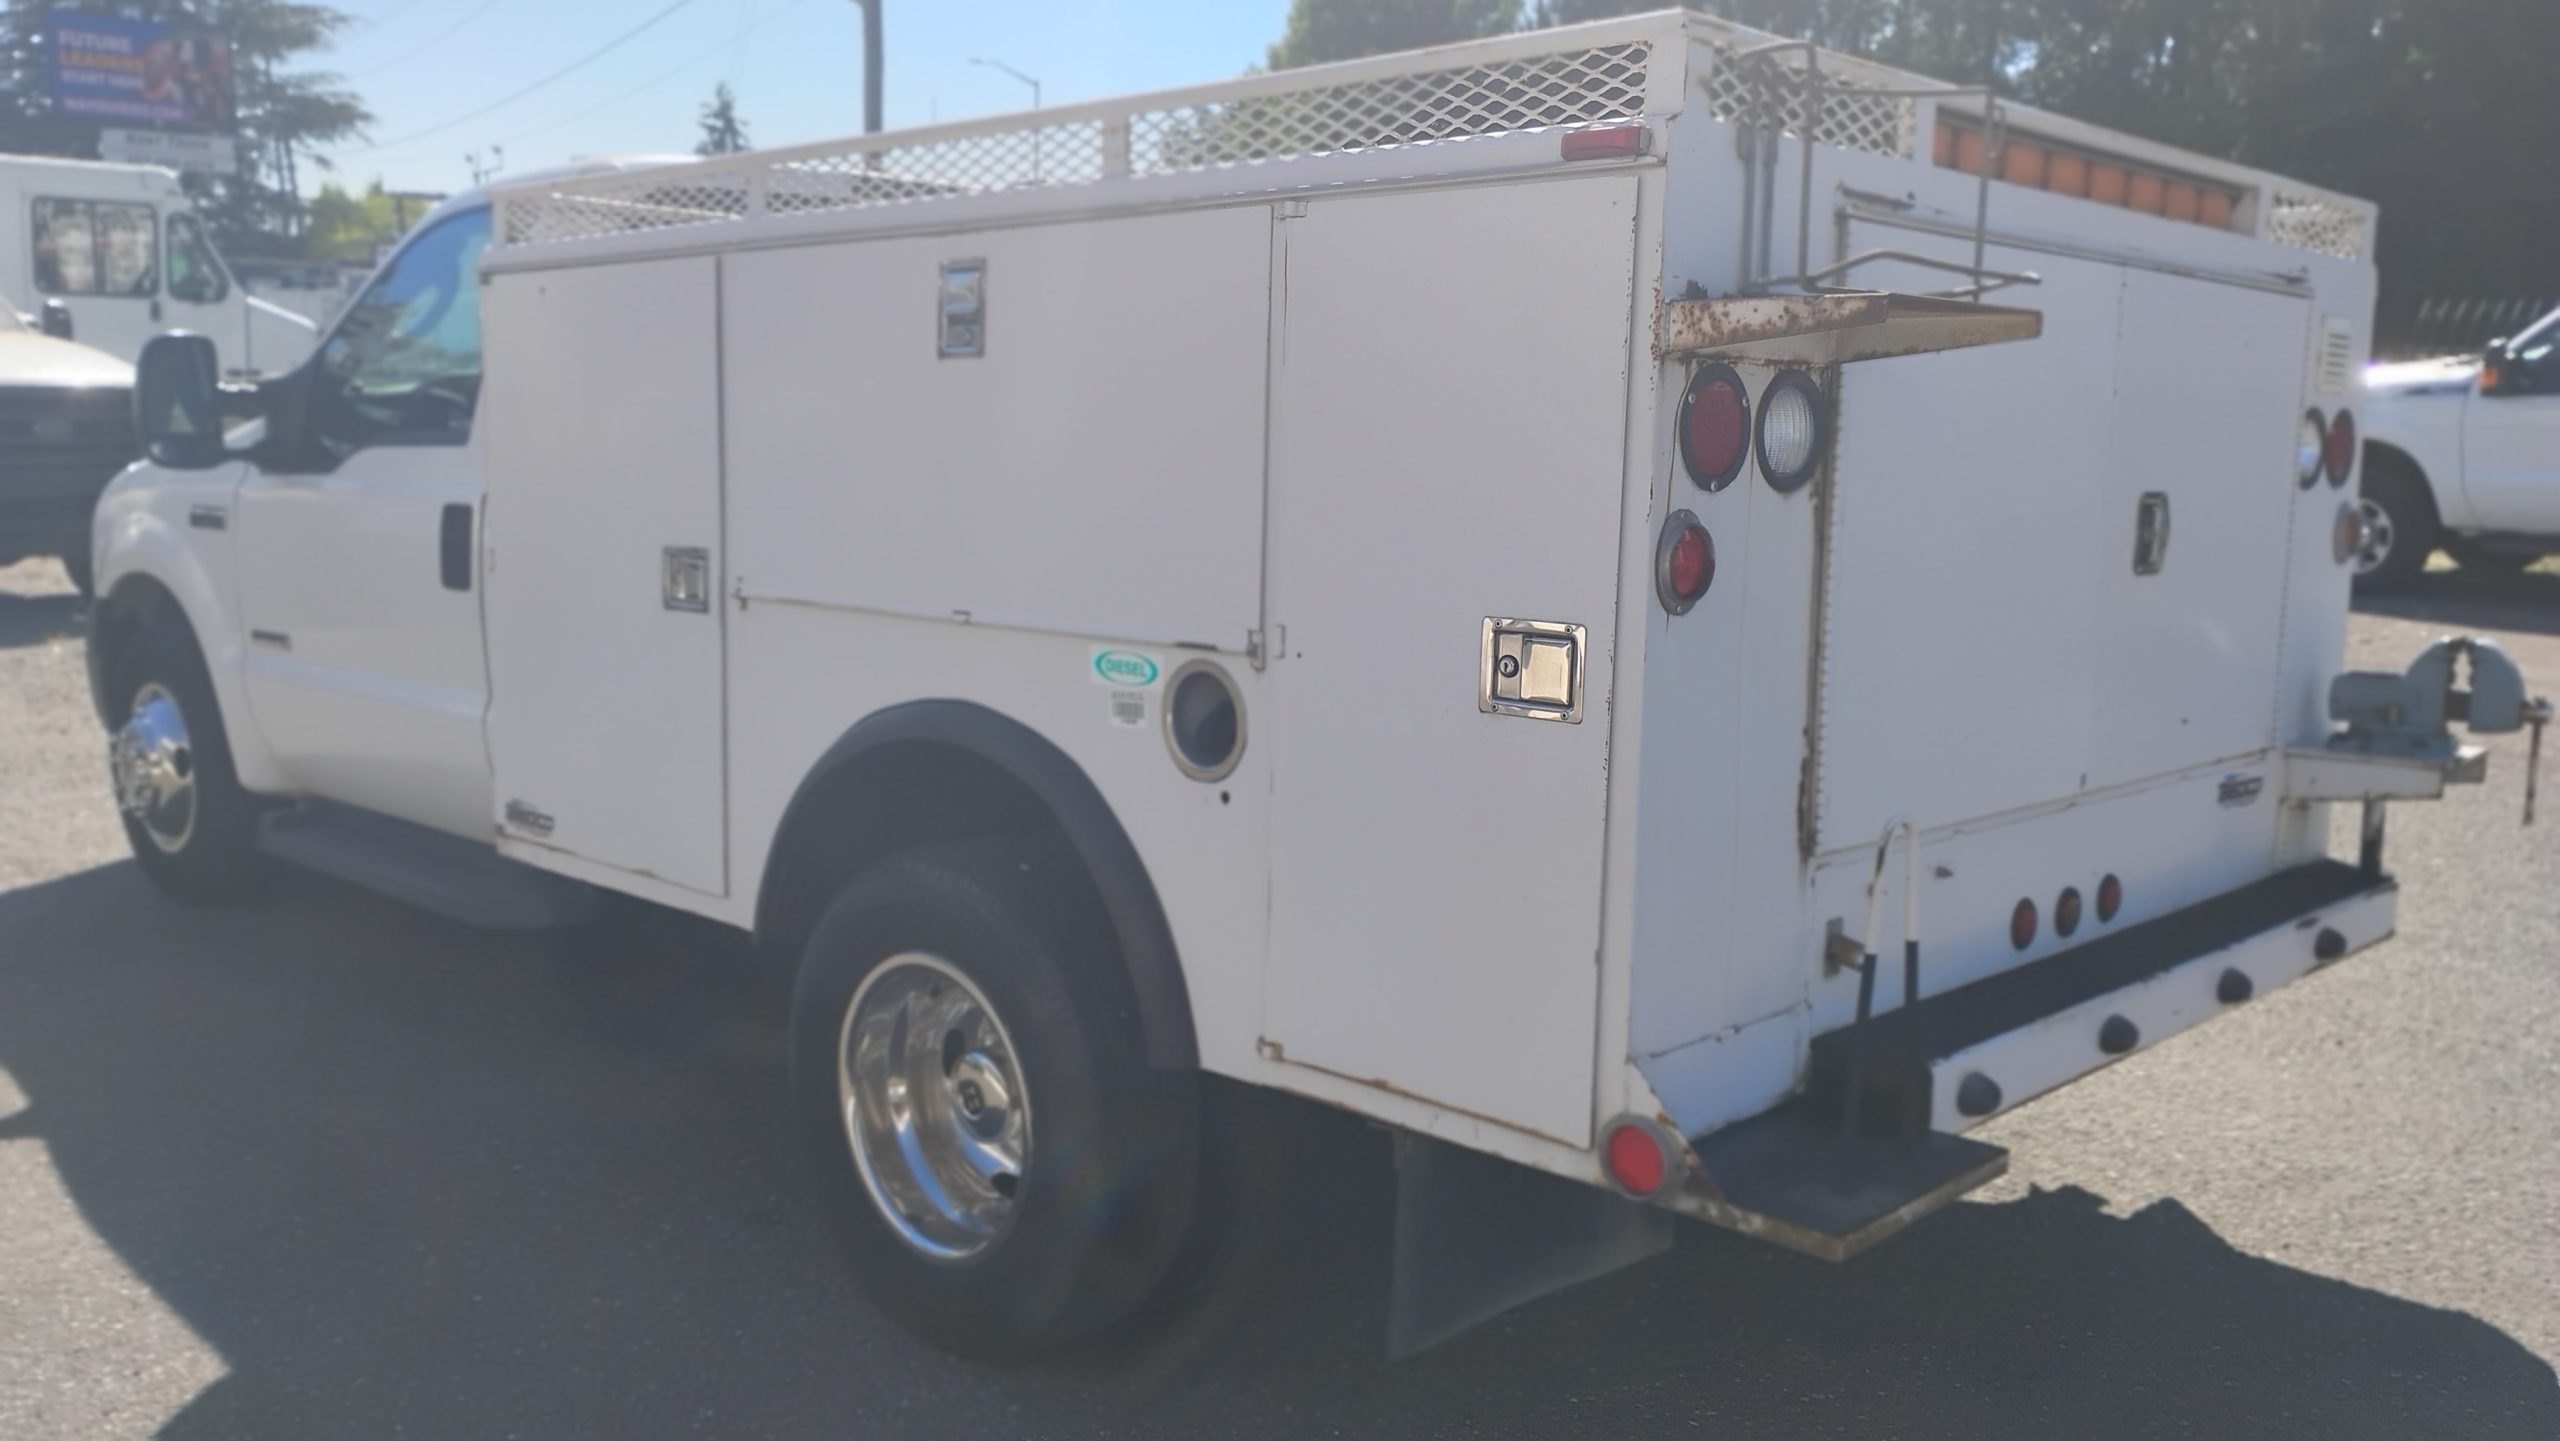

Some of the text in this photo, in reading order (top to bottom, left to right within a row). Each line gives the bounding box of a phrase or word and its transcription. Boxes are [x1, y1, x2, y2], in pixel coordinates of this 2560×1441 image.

[58, 29, 131, 54] FUTURE
[61, 69, 106, 86] START
[1105, 658, 1147, 677] DIESEL
